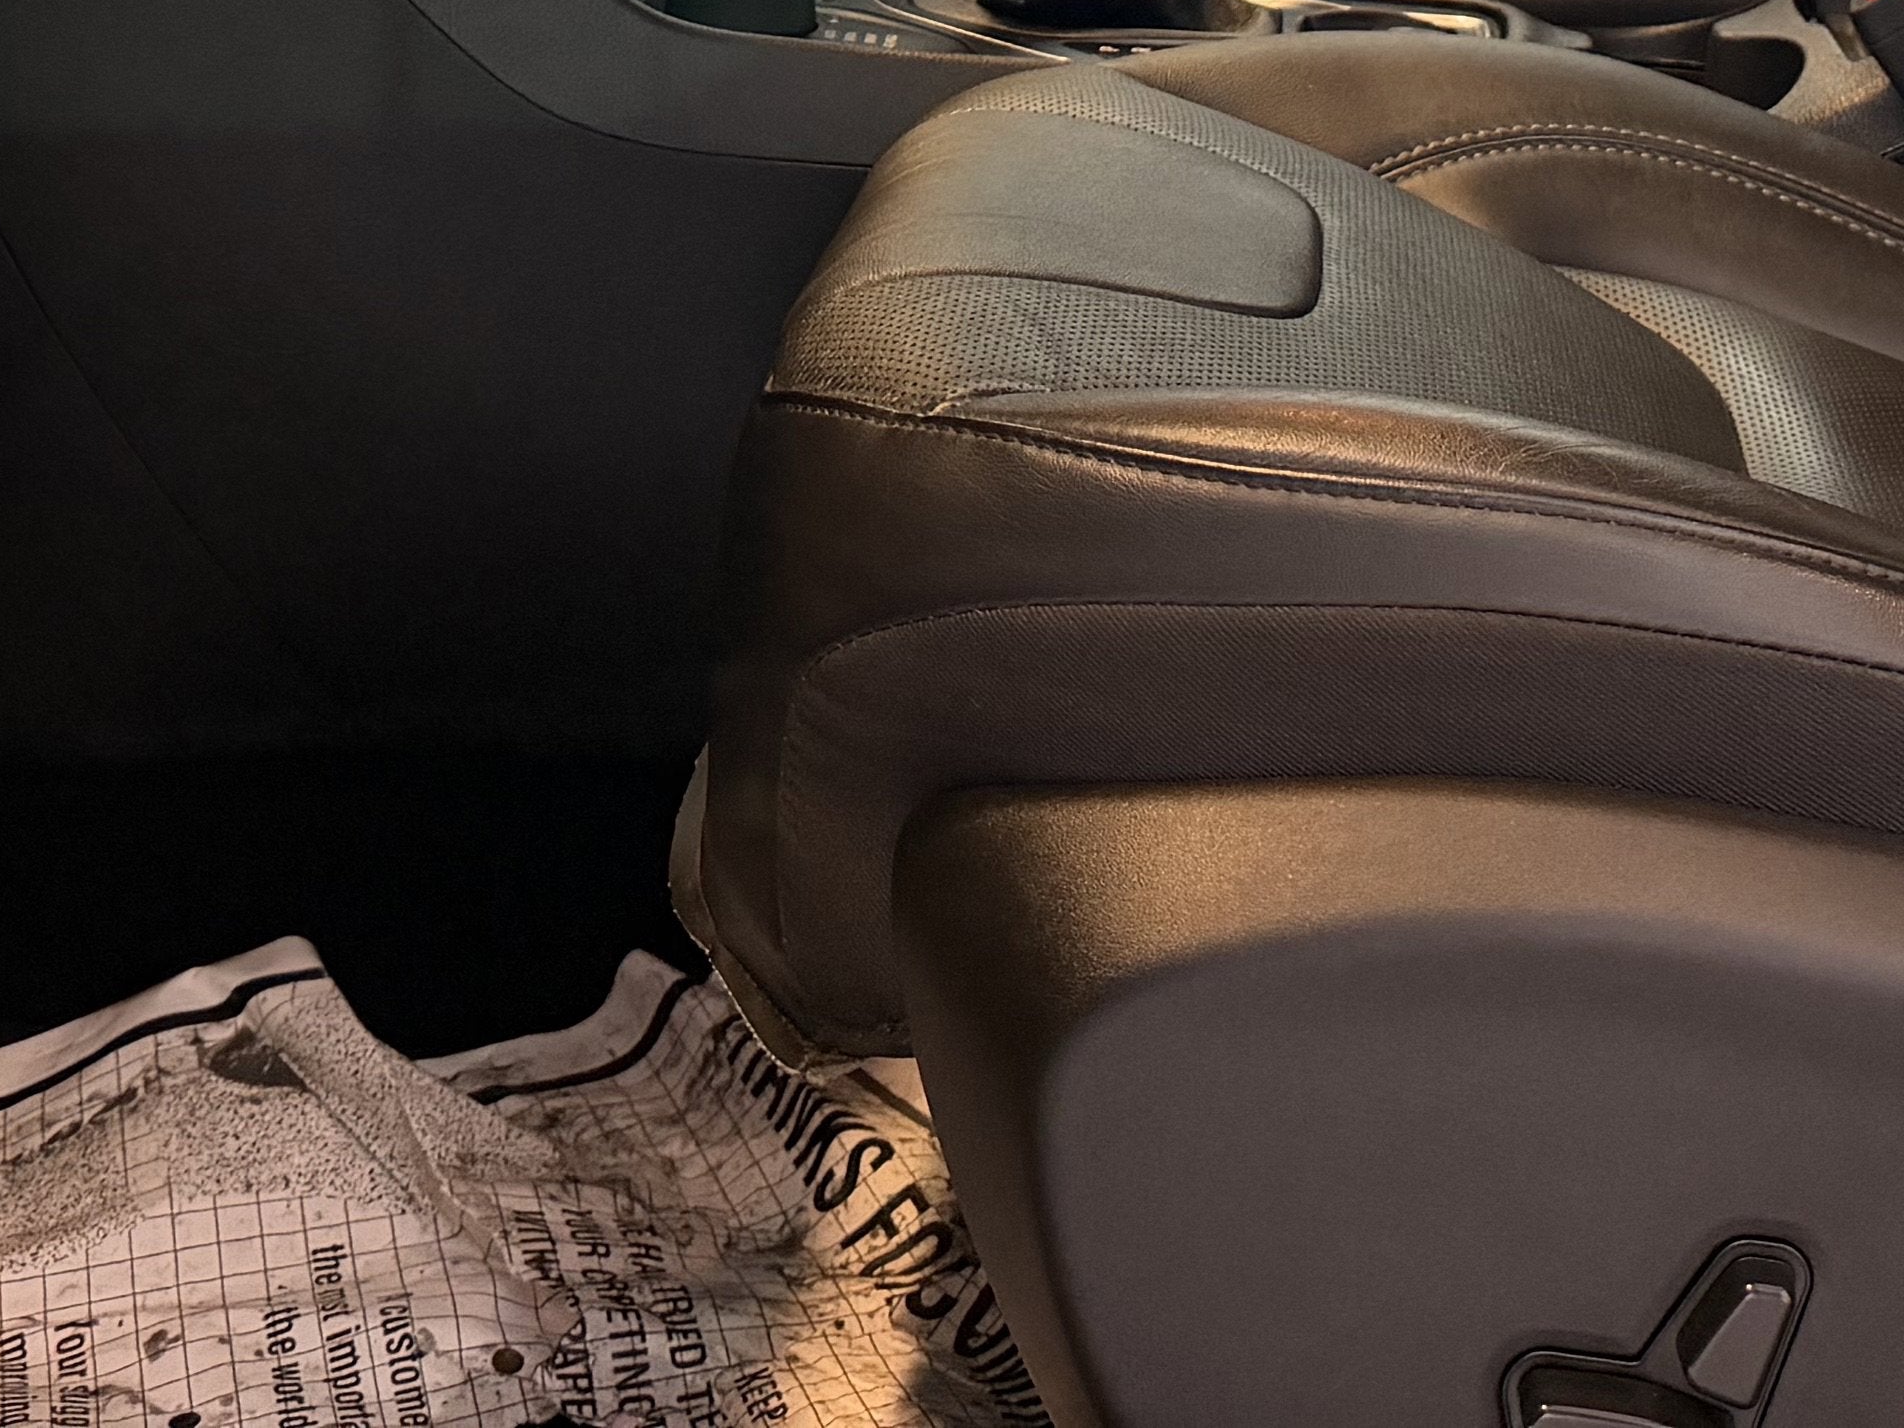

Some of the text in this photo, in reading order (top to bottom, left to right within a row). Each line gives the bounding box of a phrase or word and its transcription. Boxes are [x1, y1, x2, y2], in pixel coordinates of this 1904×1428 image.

[312, 1244, 348, 1286] the
[262, 1305, 302, 1356] the
[379, 1303, 430, 1428] custome
